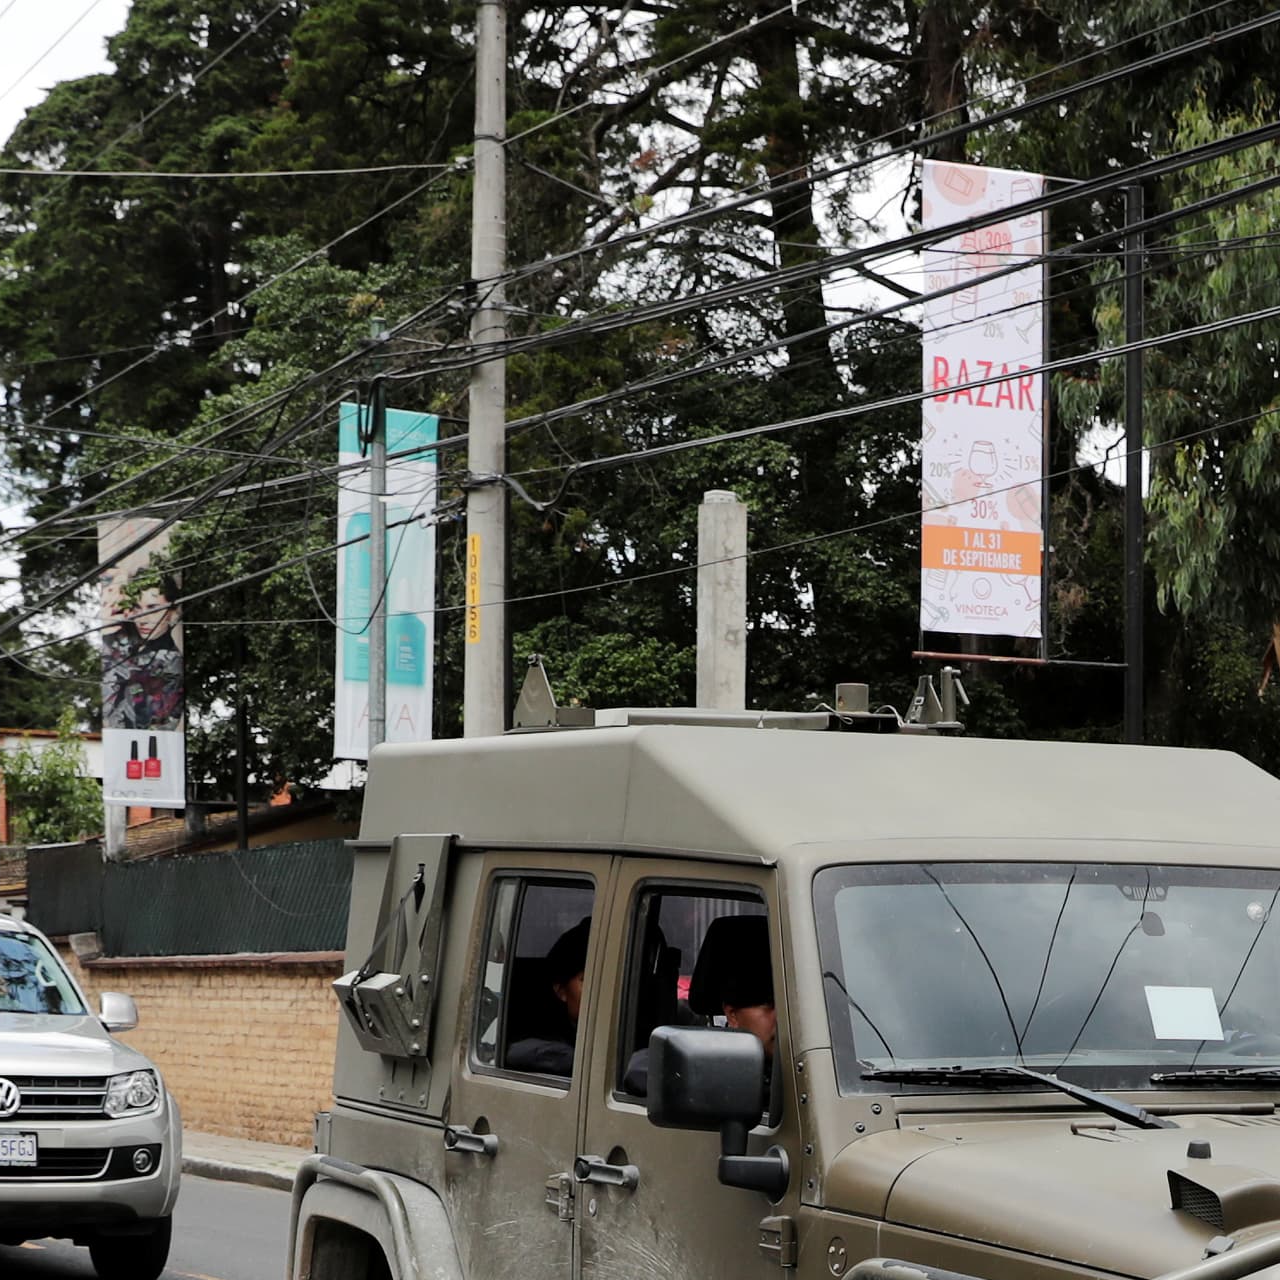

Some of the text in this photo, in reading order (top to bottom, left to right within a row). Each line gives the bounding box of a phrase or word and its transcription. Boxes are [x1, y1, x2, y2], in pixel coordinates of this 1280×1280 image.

[985, 231, 1014, 253] 30%
[983, 321, 1004, 339] 20%
[933, 356, 1036, 412] BAZAR
[929, 462, 952, 478] 20%
[1019, 454, 1040, 472] 15%
[970, 500, 999, 520] 30%
[964, 531, 1002, 549] 1 AL 31
[943, 549, 1022, 570] DE SEPTIEMBRE
[955, 603, 1009, 617] VINOTECA
